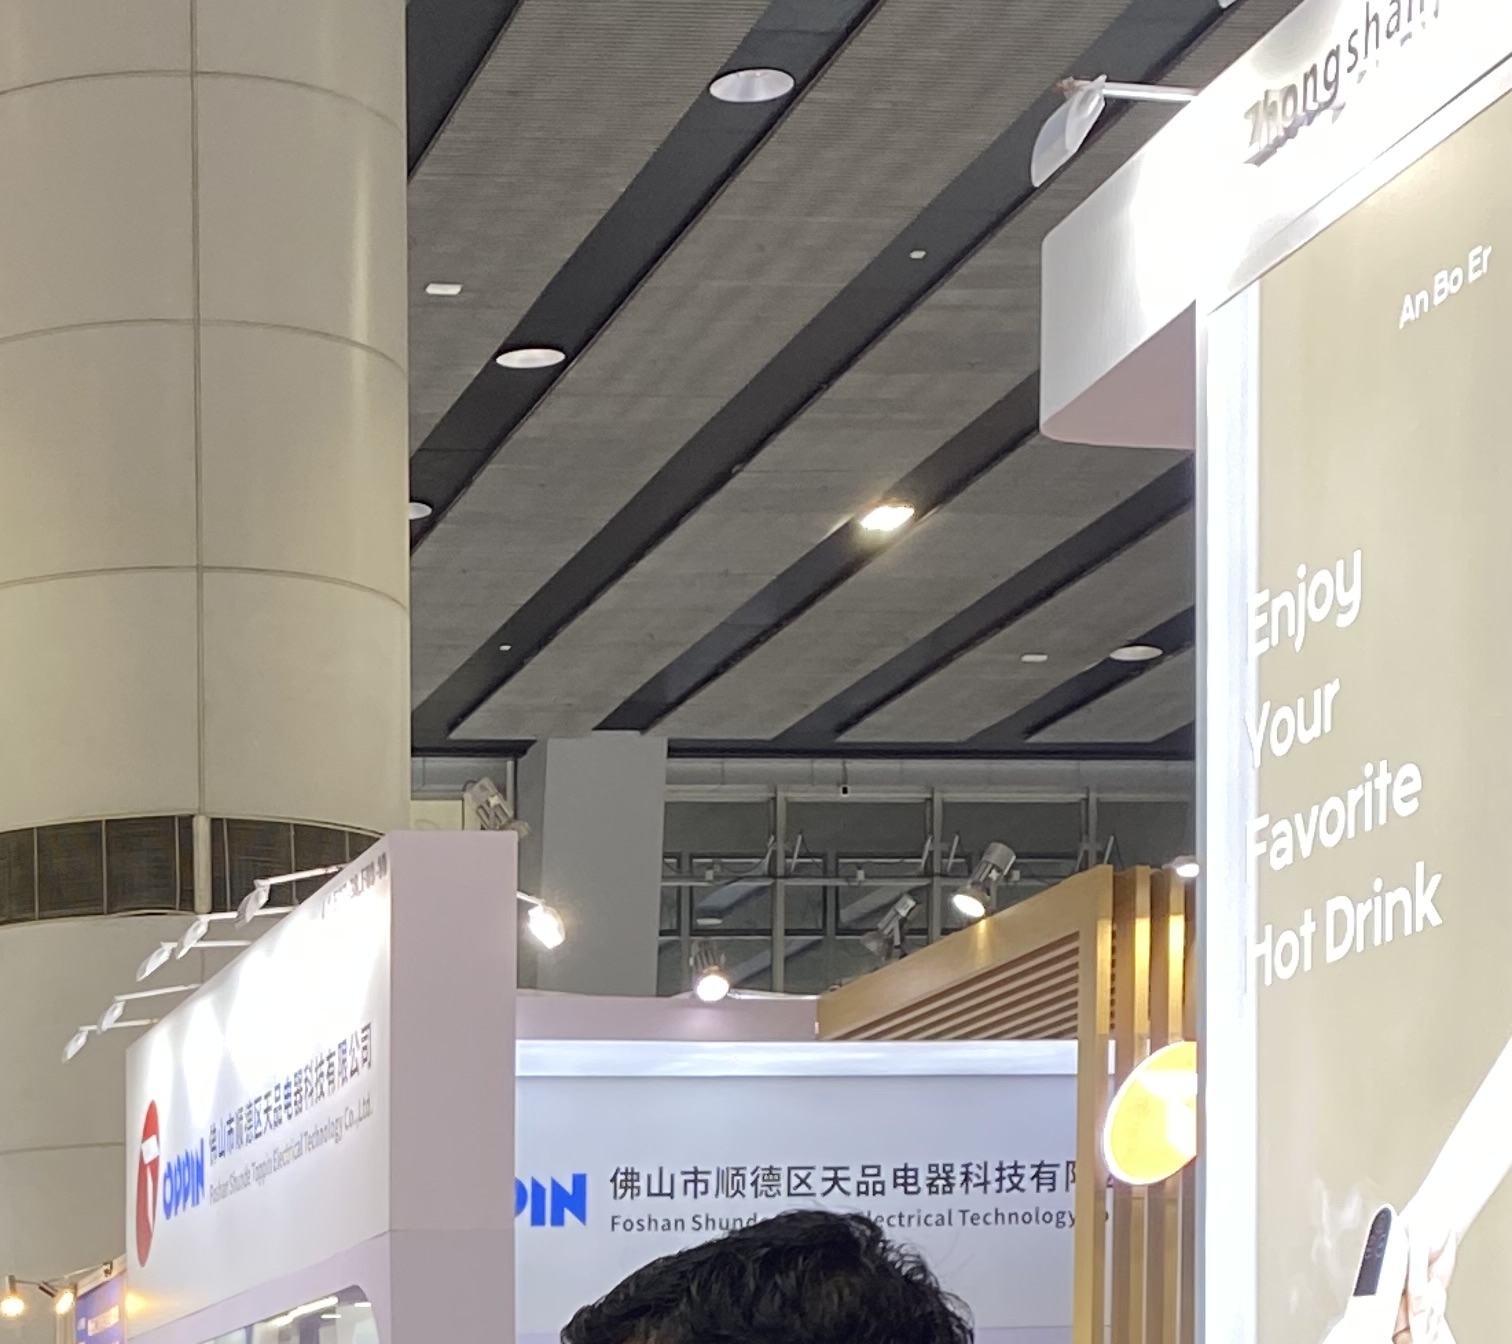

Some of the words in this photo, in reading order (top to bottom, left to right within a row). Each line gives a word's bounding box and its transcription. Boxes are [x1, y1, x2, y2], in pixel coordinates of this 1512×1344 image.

[1399, 287, 1429, 329] An
[1433, 267, 1463, 309] Bo
[1467, 243, 1493, 285] Er
[1246, 548, 1362, 659] Enjoy
[1244, 678, 1341, 768] Your
[1247, 759, 1422, 878] Favorite
[1246, 907, 1317, 988] Hot
[1326, 860, 1444, 965] Drink
[610, 1215, 686, 1233] Foshan
[691, 1212, 767, 1233] Shund
